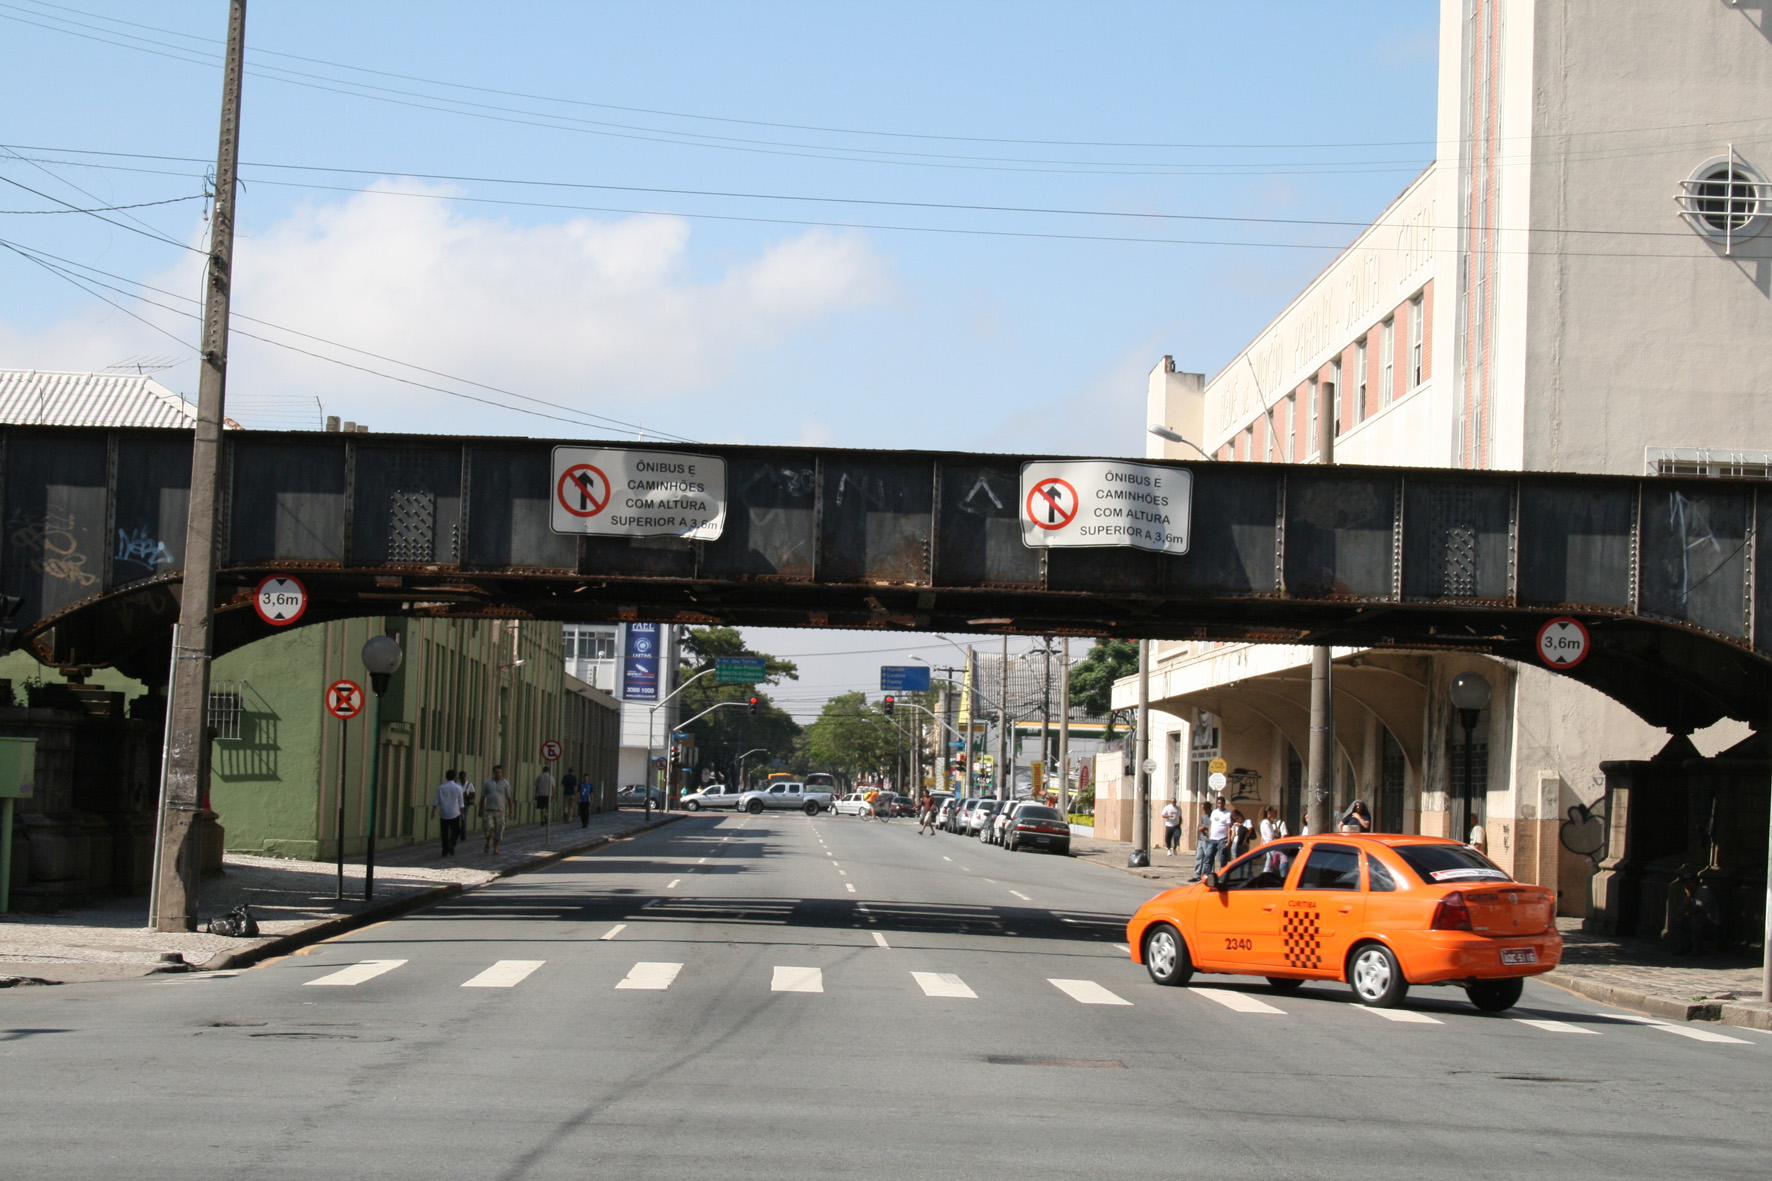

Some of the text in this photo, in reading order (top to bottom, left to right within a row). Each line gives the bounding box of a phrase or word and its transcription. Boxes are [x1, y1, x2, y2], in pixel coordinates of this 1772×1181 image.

[636, 459, 696, 475] ÔNIBUS E
[627, 480, 705, 493] CAMINHÕES
[1105, 470, 1162, 488] ÔNIBUS E
[625, 498, 707, 511] COM ALTURA
[1096, 489, 1169, 507] CAMINHÕES
[611, 515, 718, 530] SUPERIOR A 3,6m
[1094, 507, 1171, 525] COM ALTURA
[1080, 525, 1184, 545] SUPERIOR A 3,6m
[262, 592, 299, 607] 3,6m
[1544, 636, 1581, 650] 3,6m
[1288, 900, 1317, 909] CURITIBA
[1225, 938, 1252, 951] 2340
